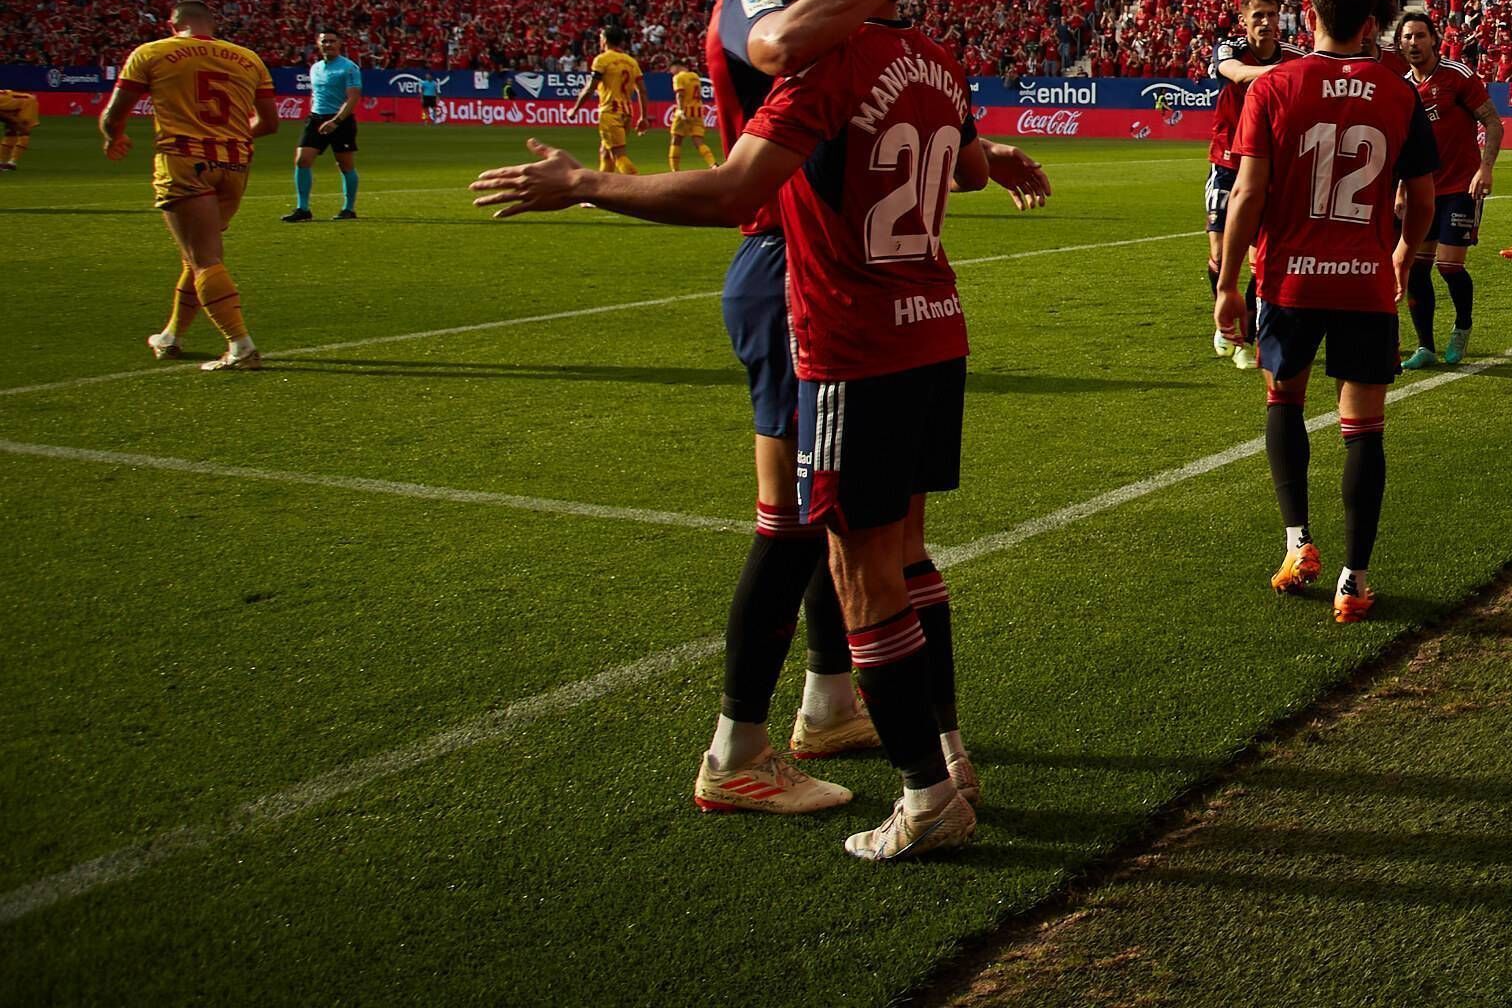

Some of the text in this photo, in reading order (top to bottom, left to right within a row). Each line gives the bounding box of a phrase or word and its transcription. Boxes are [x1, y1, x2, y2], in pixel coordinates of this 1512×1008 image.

[165, 46, 208, 64] DAVID
[548, 74, 565, 87] EL
[1322, 78, 1377, 102] ABDE
[195, 70, 230, 126] 5
[1037, 82, 1096, 105] enhol
[449, 100, 506, 123] LaLiga
[1299, 122, 1387, 224] 12
[864, 122, 962, 264] 20
[1286, 255, 1380, 276] HRmotor
